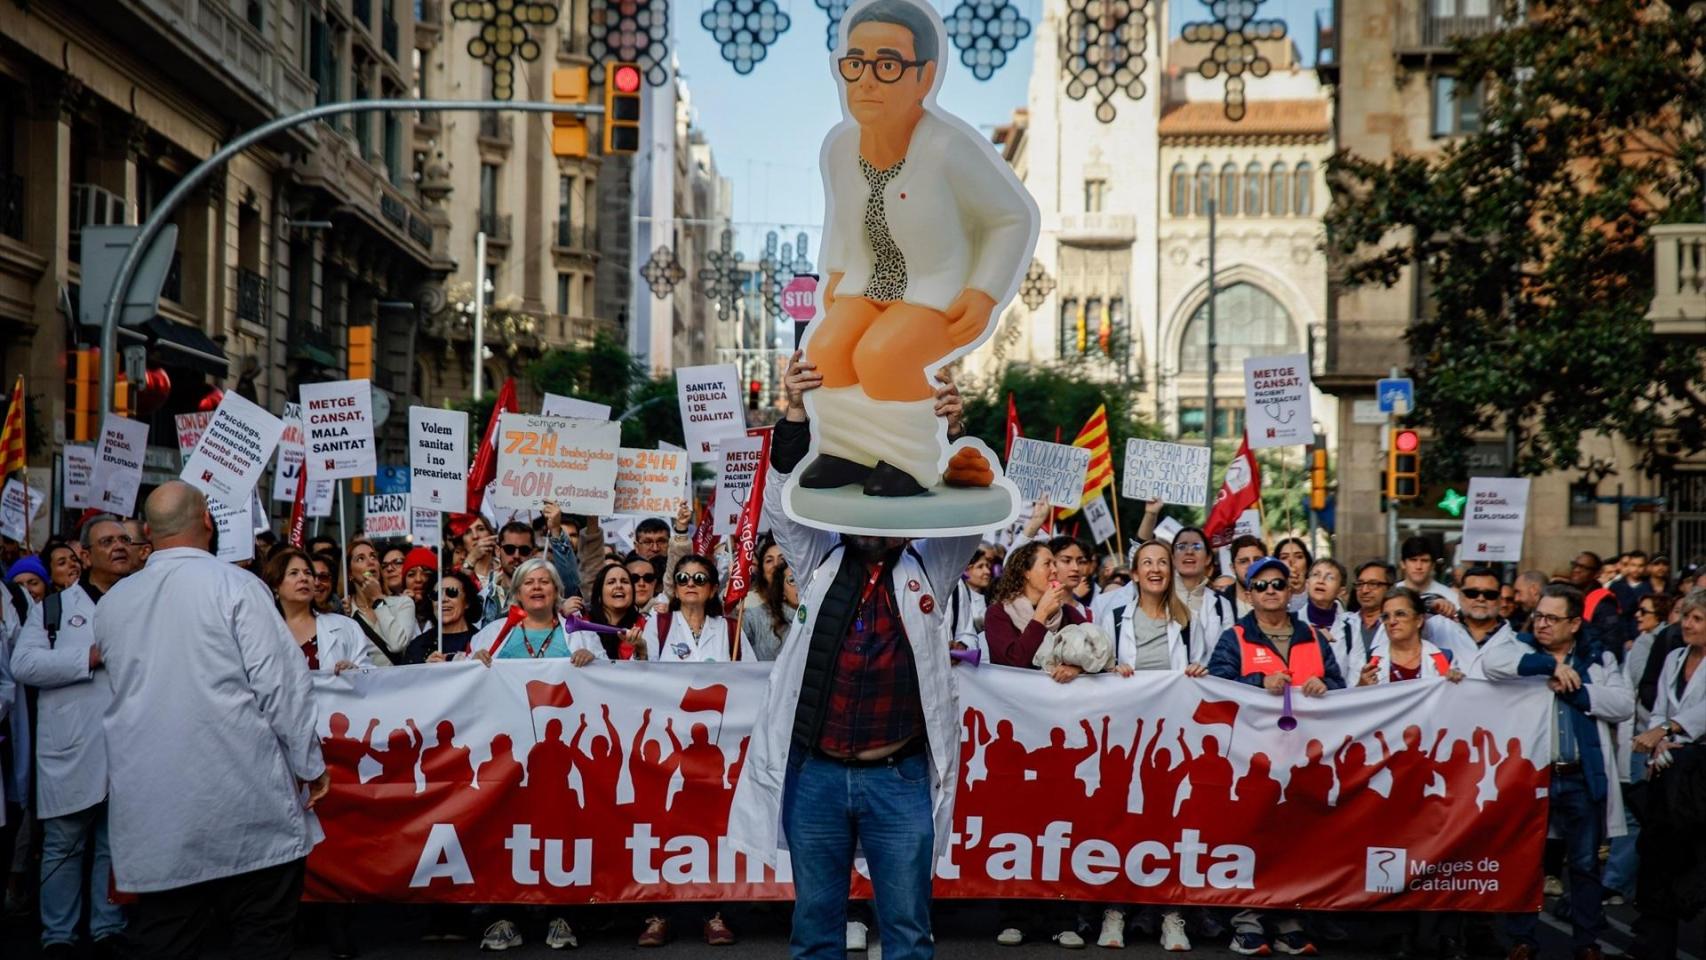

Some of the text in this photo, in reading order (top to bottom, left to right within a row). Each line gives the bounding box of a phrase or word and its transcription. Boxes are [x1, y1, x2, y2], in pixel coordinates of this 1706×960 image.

[785, 291, 813, 307] STO
[1254, 367, 1295, 379] METGE
[685, 381, 726, 392] SANITAT,
[1254, 377, 1303, 390] CANSAT,
[687, 391, 728, 402] PÚBLICA
[1254, 389, 1285, 397] PACIENT
[309, 397, 356, 410] METGE
[694, 403, 707, 412] DE
[310, 411, 365, 425] CANSAT,
[527, 418, 566, 429] Semana
[690, 411, 734, 423] QUALITAT
[218, 409, 262, 441] Psicòlegs,
[421, 421, 453, 436] Volem
[107, 430, 115, 438] NO
[214, 420, 262, 453] odontòlegs,
[311, 426, 349, 439] MALA
[209, 428, 263, 465] farmacòlegs,
[313, 439, 367, 453] SANITAT
[419, 439, 453, 451] sanitat
[504, 430, 559, 456] 72H
[204, 437, 251, 469] també som
[427, 453, 445, 466] i no
[726, 450, 763, 461] METGE
[199, 446, 244, 476] facultatius
[536, 457, 588, 471] tributadas
[635, 450, 678, 471] 24H
[726, 462, 760, 473] CANSA
[413, 467, 462, 481] precarietat
[501, 469, 555, 497] 40H
[555, 484, 609, 499] cotizadas
[408, 823, 475, 888] A
[504, 823, 593, 887] tu
[1409, 857, 1500, 876] Metges de
[1409, 876, 1499, 895] Catalunya
